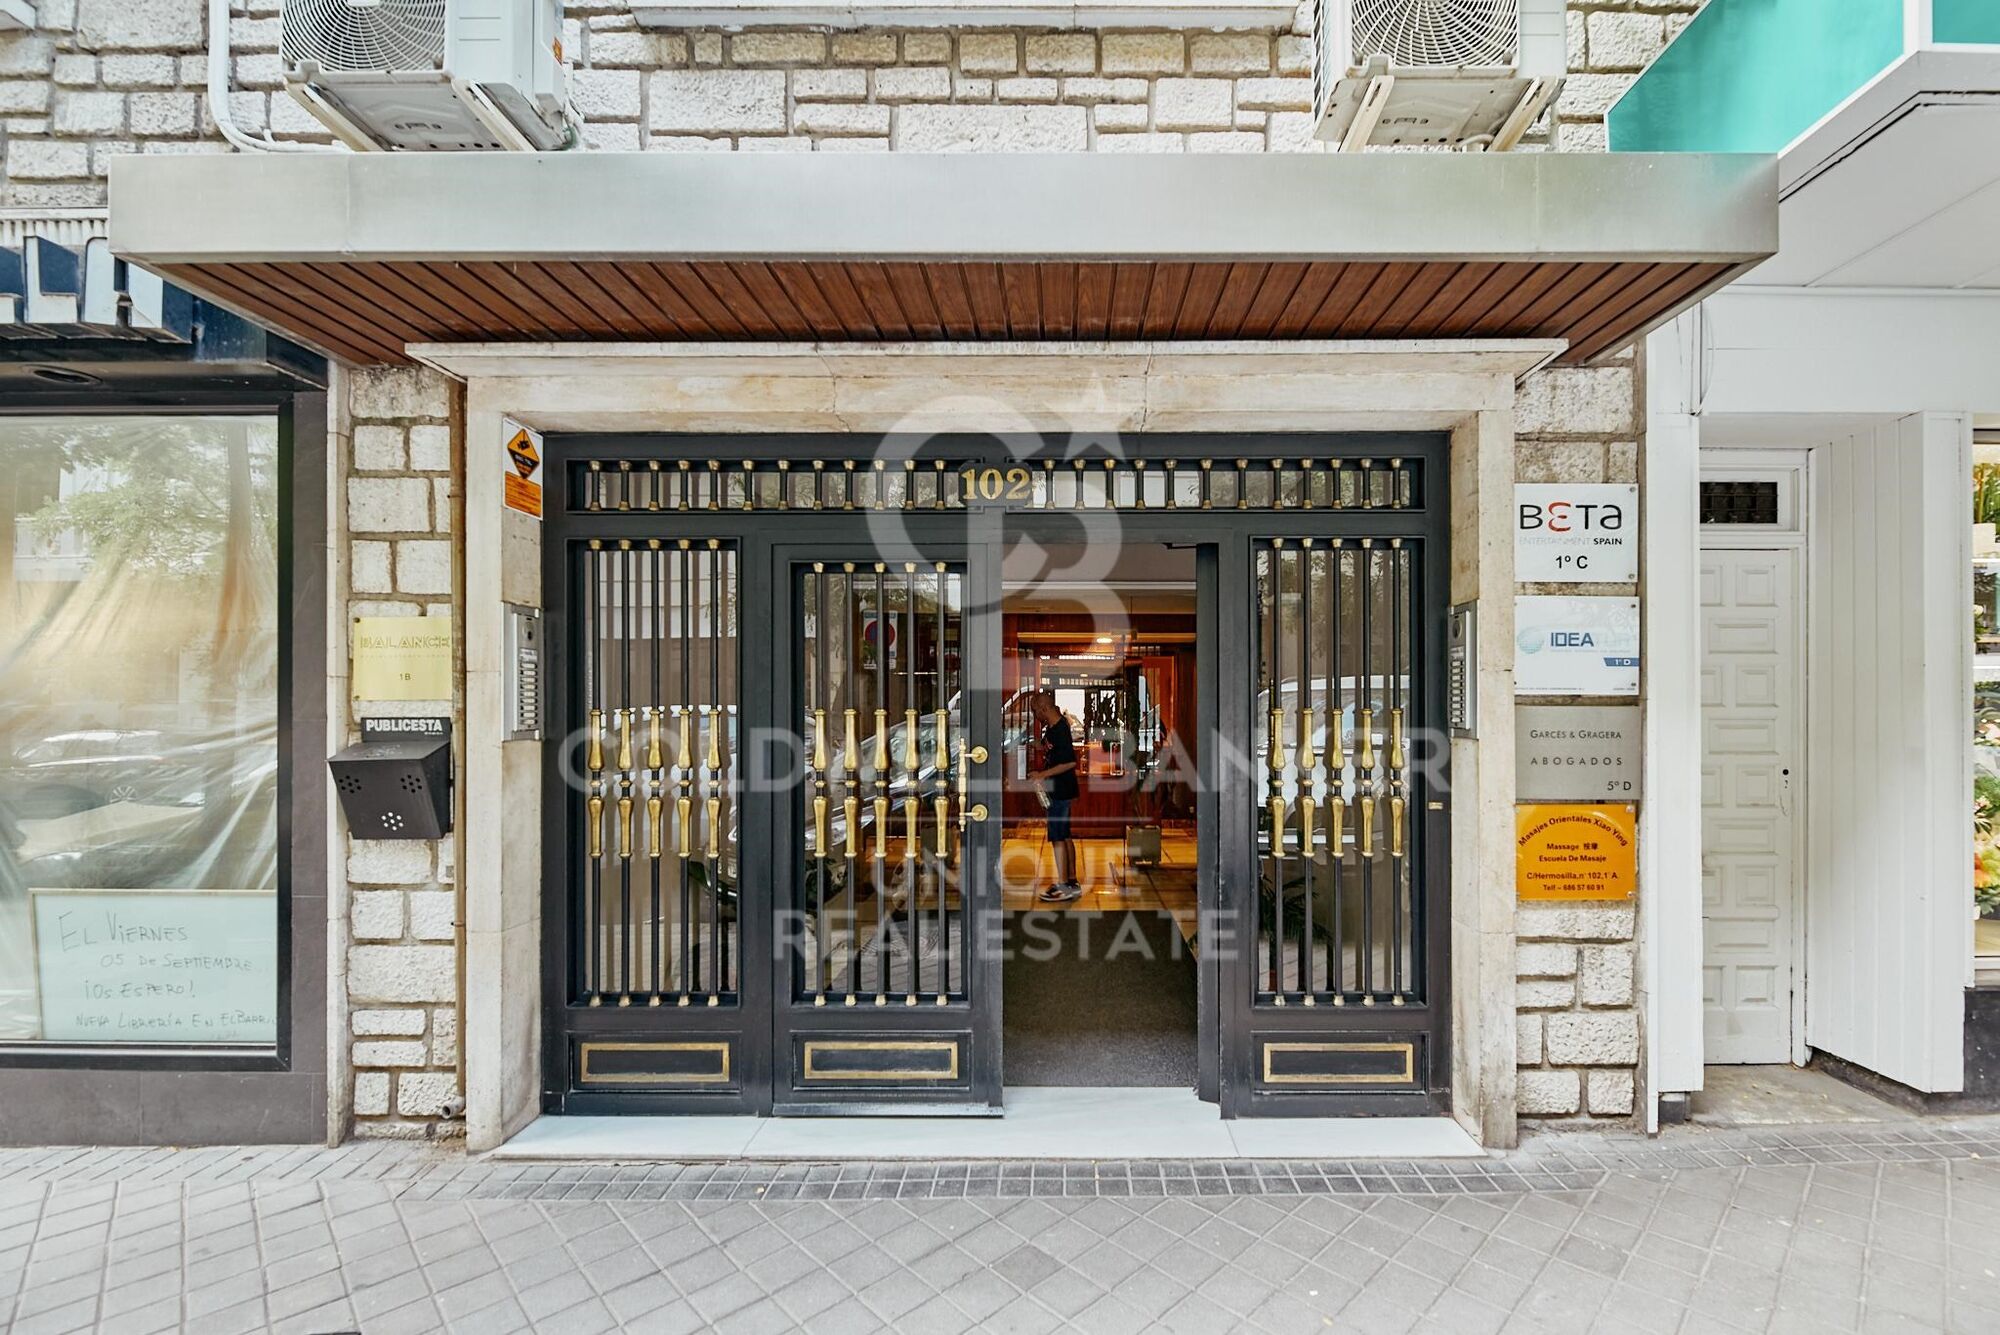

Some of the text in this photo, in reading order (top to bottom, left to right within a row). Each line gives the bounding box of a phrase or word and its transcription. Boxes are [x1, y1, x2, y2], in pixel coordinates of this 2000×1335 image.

[961, 467, 1030, 500] 102
[1576, 555, 1588, 569] C
[366, 720, 443, 731] PUBLICESTA
[1530, 757, 1622, 765] ABOGADOS
[1623, 781, 1631, 790] D
[1518, 815, 1628, 847] Masajes Orientales Xiao Ying
[1547, 843, 1579, 851] Massage
[1580, 855, 1607, 863] Masaje
[100, 953, 124, 968] 05
